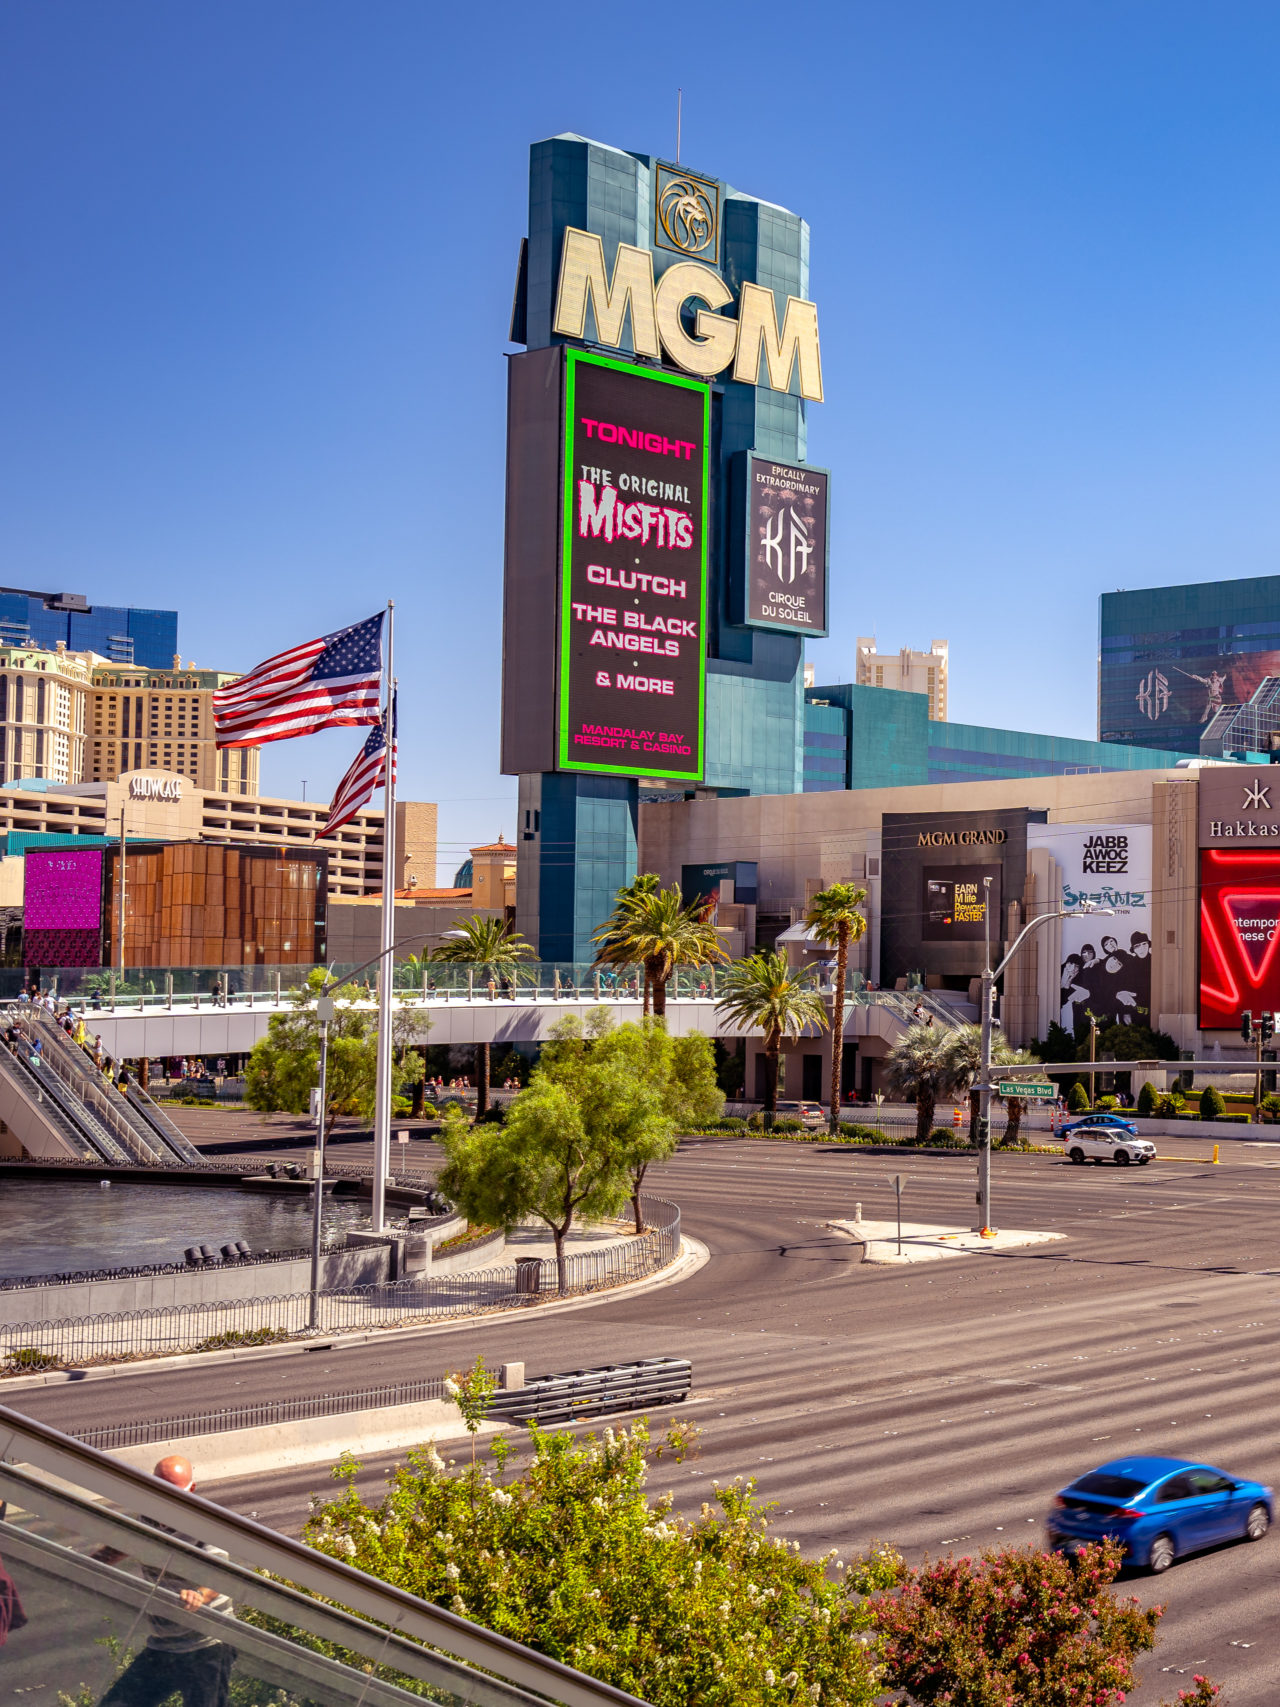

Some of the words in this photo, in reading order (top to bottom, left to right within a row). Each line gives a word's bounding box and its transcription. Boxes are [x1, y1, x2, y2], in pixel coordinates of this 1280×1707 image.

[553, 226, 824, 402] MGM
[581, 418, 696, 460] TONIGHT
[771, 466, 806, 481] EPICALLY
[581, 465, 612, 485] THE
[618, 473, 691, 504] ORIGINAL
[756, 473, 820, 496] EXTRAORDINARY
[586, 564, 687, 598] CLUTCH
[768, 591, 806, 610] CIRQUE
[572, 602, 617, 625] THE
[623, 611, 697, 638] BLACK
[761, 604, 776, 617] DU
[778, 607, 812, 623] SOLEIL
[589, 630, 680, 657] ANGELS
[596, 671, 611, 688] &
[616, 673, 675, 695] MORE
[582, 724, 655, 741] MANDALAY
[659, 731, 685, 743] BAY
[574, 734, 627, 750] RESORT
[630, 739, 640, 750] &
[643, 740, 691, 755] CASINO
[131, 776, 182, 799] SHOWCASE
[918, 831, 956, 847] MGM
[960, 829, 1005, 845] GRAND
[1083, 835, 1128, 848] JABB
[1083, 849, 1128, 860] AWOC
[1082, 861, 1128, 873] KEEZ
[954, 894, 963, 903] M
[964, 894, 977, 903] life
[955, 884, 977, 894] EARN
[954, 902, 986, 912] Reward
[954, 911, 984, 922] FASTER.
[1015, 1085, 1035, 1095] Vegas
[1037, 1086, 1051, 1095] Blvd
